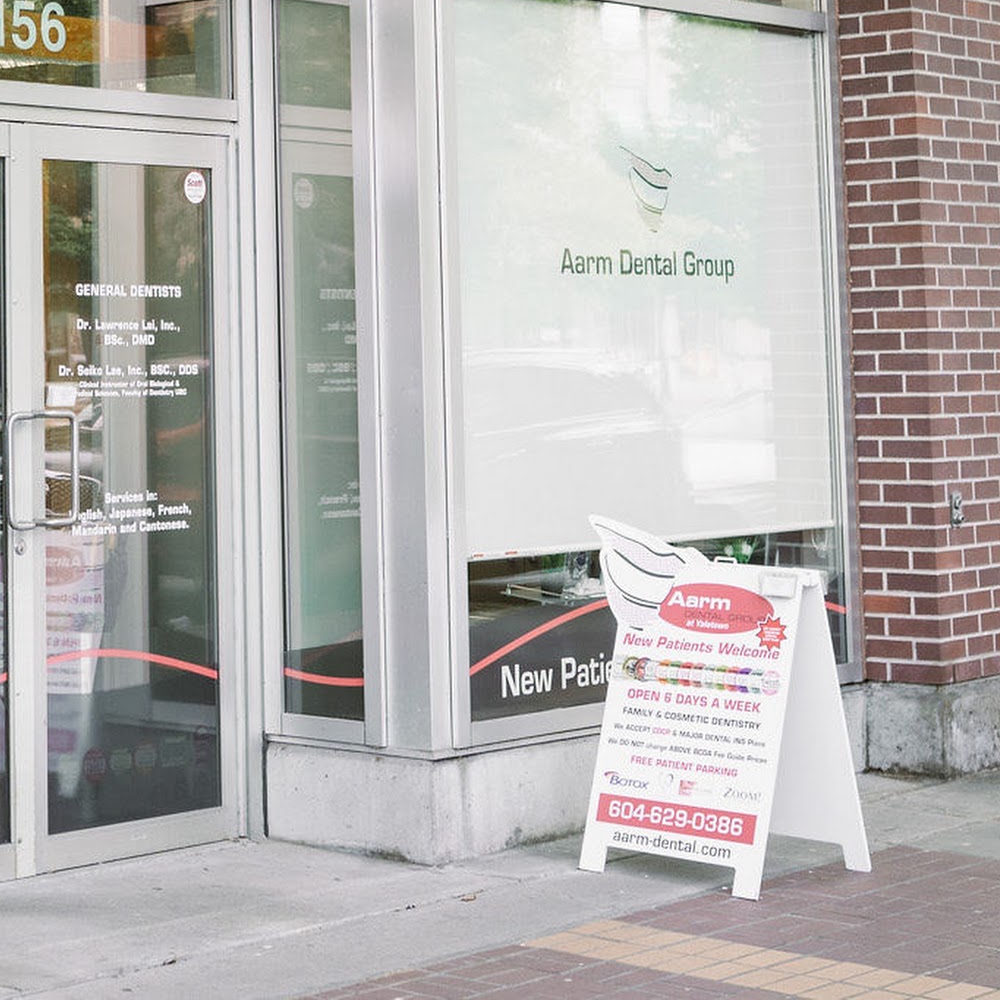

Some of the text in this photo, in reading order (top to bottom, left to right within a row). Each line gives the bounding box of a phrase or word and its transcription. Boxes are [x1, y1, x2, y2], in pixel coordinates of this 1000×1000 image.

[560, 248, 735, 284] Aarm Dental Group
[75, 283, 182, 298] GENERAL DENTISTS
[76, 319, 92, 330] Dr.
[95, 319, 139, 331] Lawrence
[160, 320, 181, 332] Inc.,
[104, 334, 155, 347] BSc., DMD
[58, 365, 74, 376] Dr.
[127, 365, 148, 378] Inc.,
[178, 364, 199, 376] DDS
[105, 491, 144, 504] Services
[109, 507, 156, 521] Japanese,
[158, 503, 192, 516] French,
[72, 520, 190, 536] Mandarin and Cantonese.
[668, 591, 731, 611] Aarm
[684, 610, 722, 622] DENTAL
[623, 633, 780, 660] New Patients Welcome
[501, 664, 553, 698] New
[627, 688, 762, 713] OPEN 6 DAYS A WEEK
[622, 706, 654, 718] FAMILY
[664, 712, 709, 725] COSMETIC
[712, 718, 762, 730] DENTISTRY
[626, 725, 651, 734] ACCEPT
[679, 731, 703, 740] MAJOR
[705, 734, 731, 743] DENTAL
[631, 740, 645, 748] NOT
[669, 745, 692, 755] ABOVE
[714, 751, 725, 759] Fee
[631, 755, 739, 777] FREE PATIENT PARKING
[608, 800, 743, 836] 604-629-0386
